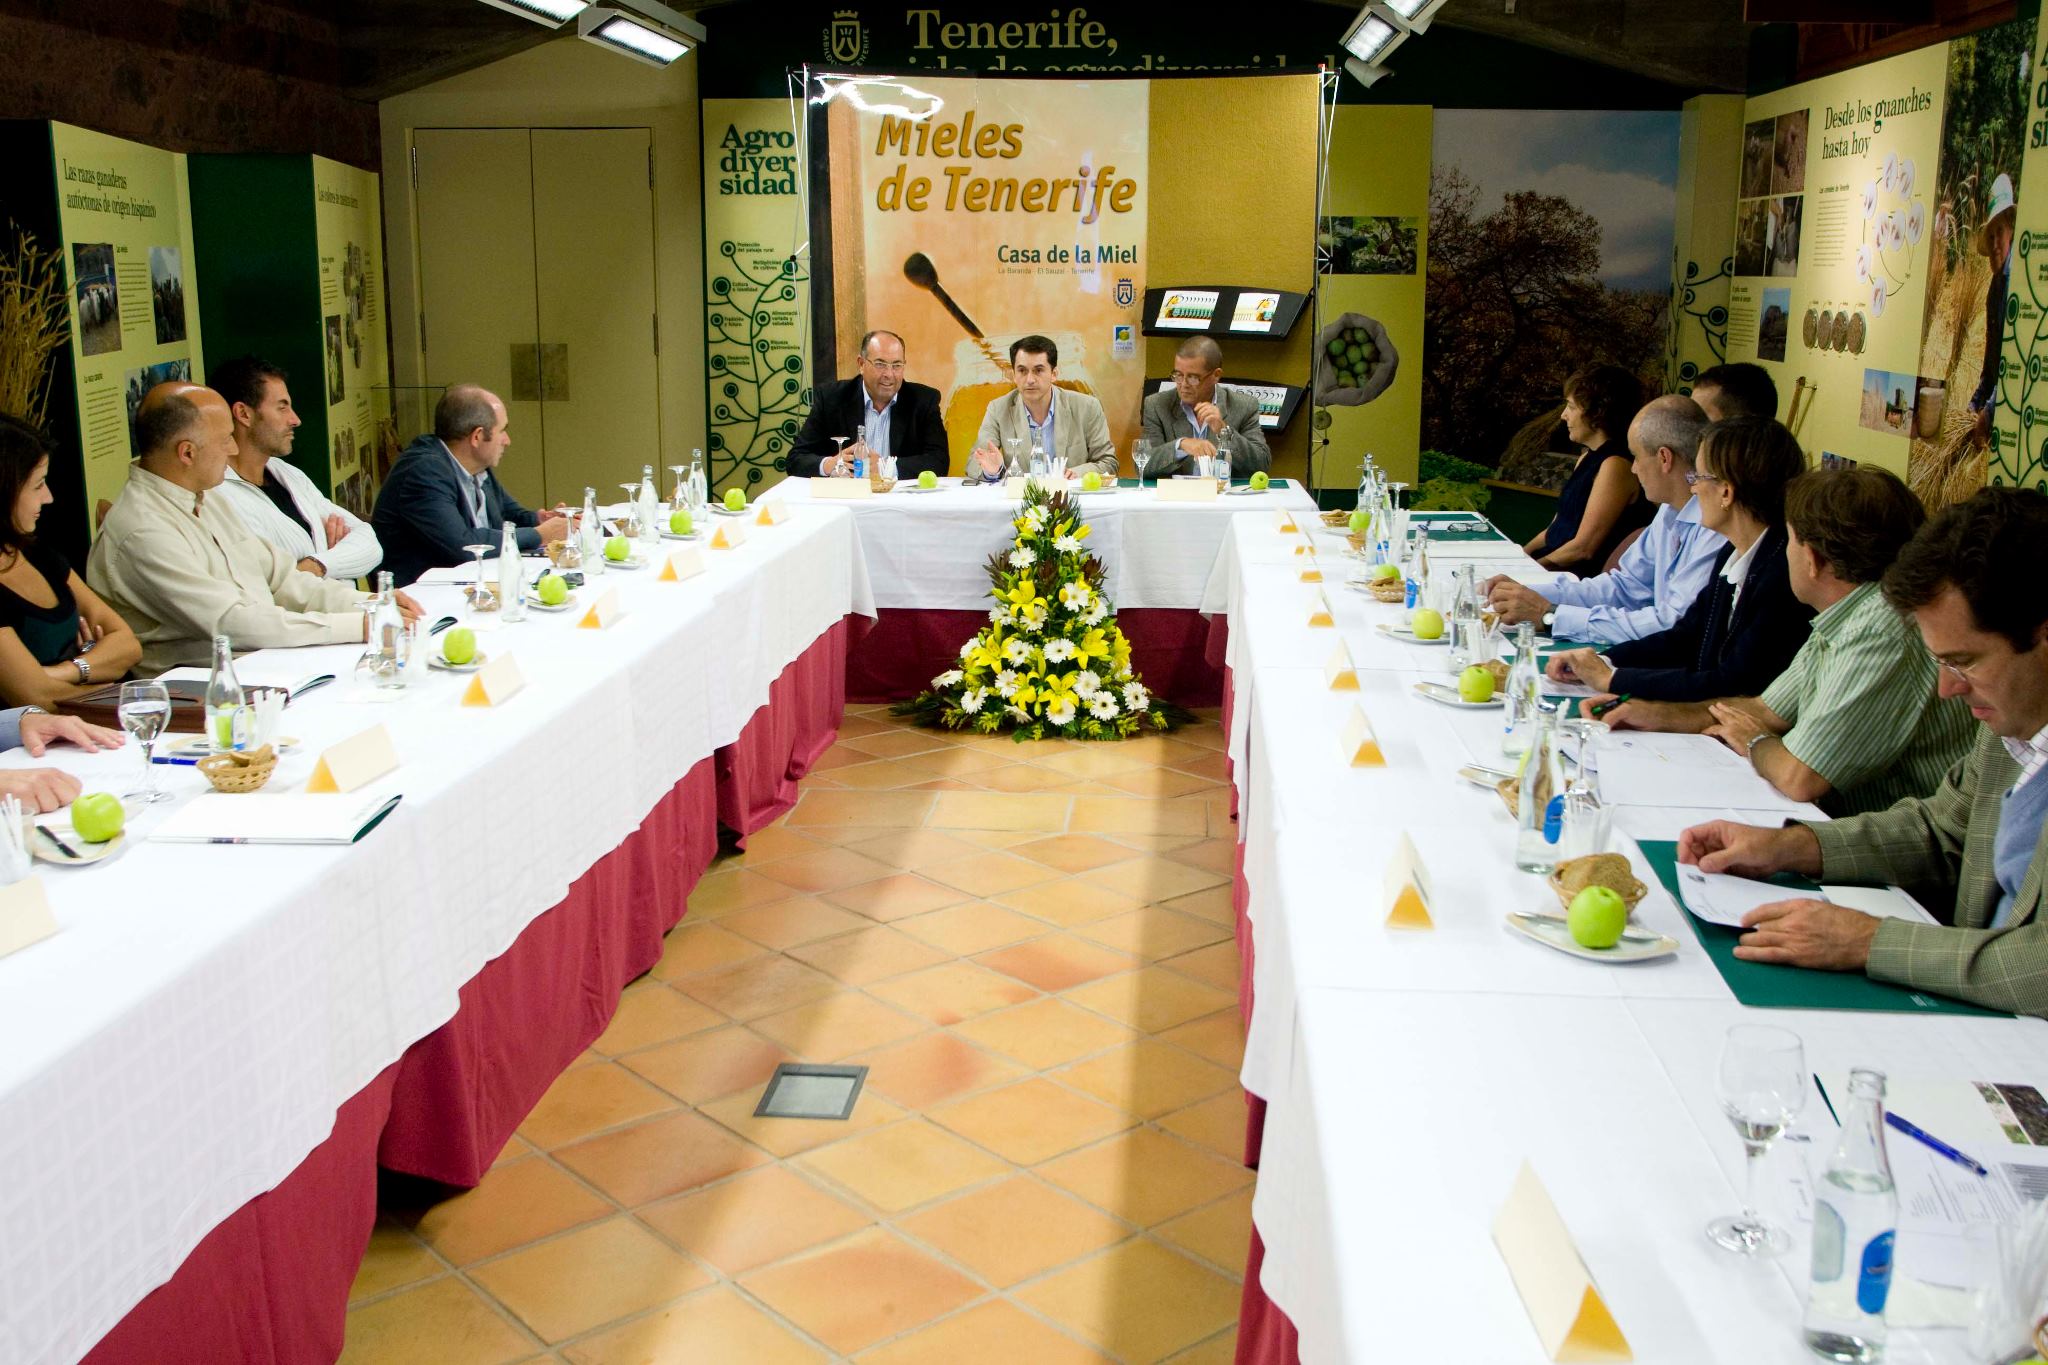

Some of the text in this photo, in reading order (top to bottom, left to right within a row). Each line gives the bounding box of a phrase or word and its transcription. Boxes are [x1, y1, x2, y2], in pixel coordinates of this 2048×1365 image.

[906, 8, 1118, 56] Tenerife,
[1825, 86, 1932, 134] Desde los guanches
[720, 123, 795, 155] Agro
[875, 109, 1024, 159] Mieles
[1822, 131, 1871, 160] hasta hoy
[63, 158, 77, 181] Las
[96, 167, 128, 191] ganaderas
[720, 149, 796, 172] diver
[720, 171, 798, 195] sidad
[876, 163, 1137, 224] de Tenerife
[103, 193, 111, 213] de
[111, 196, 131, 219] origen
[997, 244, 1138, 264] Casa de la Miel
